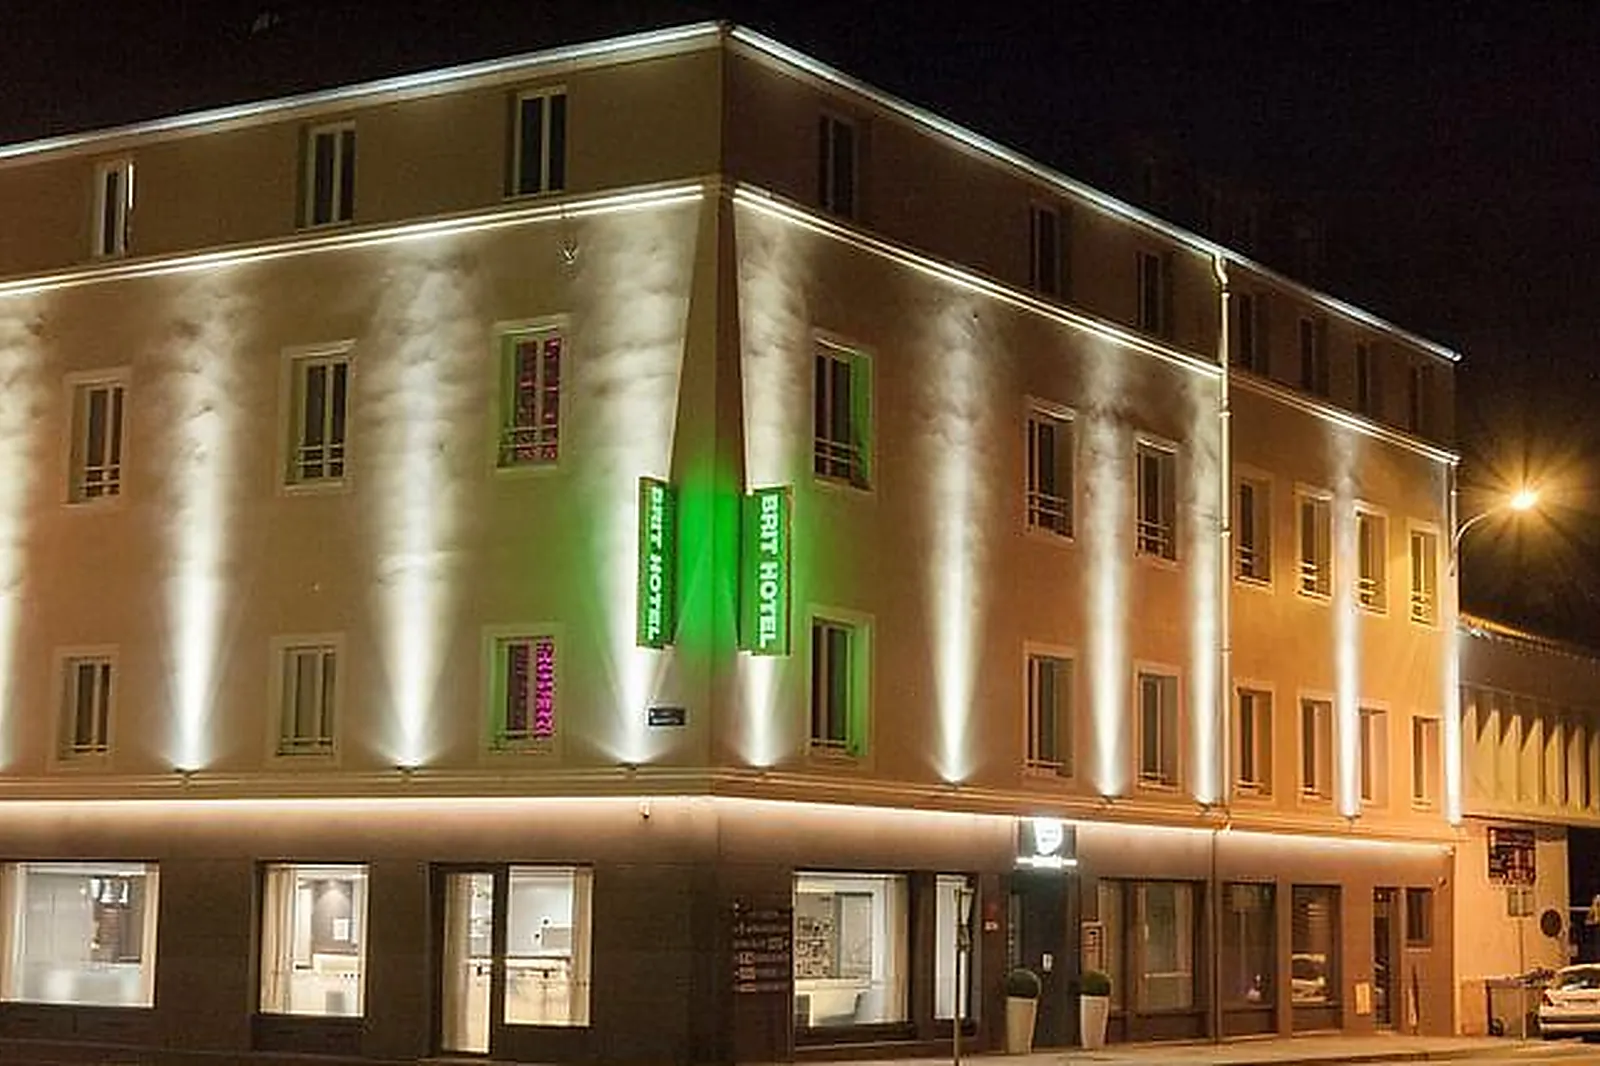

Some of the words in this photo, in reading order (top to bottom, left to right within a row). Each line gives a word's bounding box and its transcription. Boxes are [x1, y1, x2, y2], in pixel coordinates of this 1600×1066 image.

[650, 486, 664, 550] BRIT
[760, 494, 779, 555] BRIT
[648, 553, 662, 640] HOTEL
[759, 561, 778, 649] HOTEL
